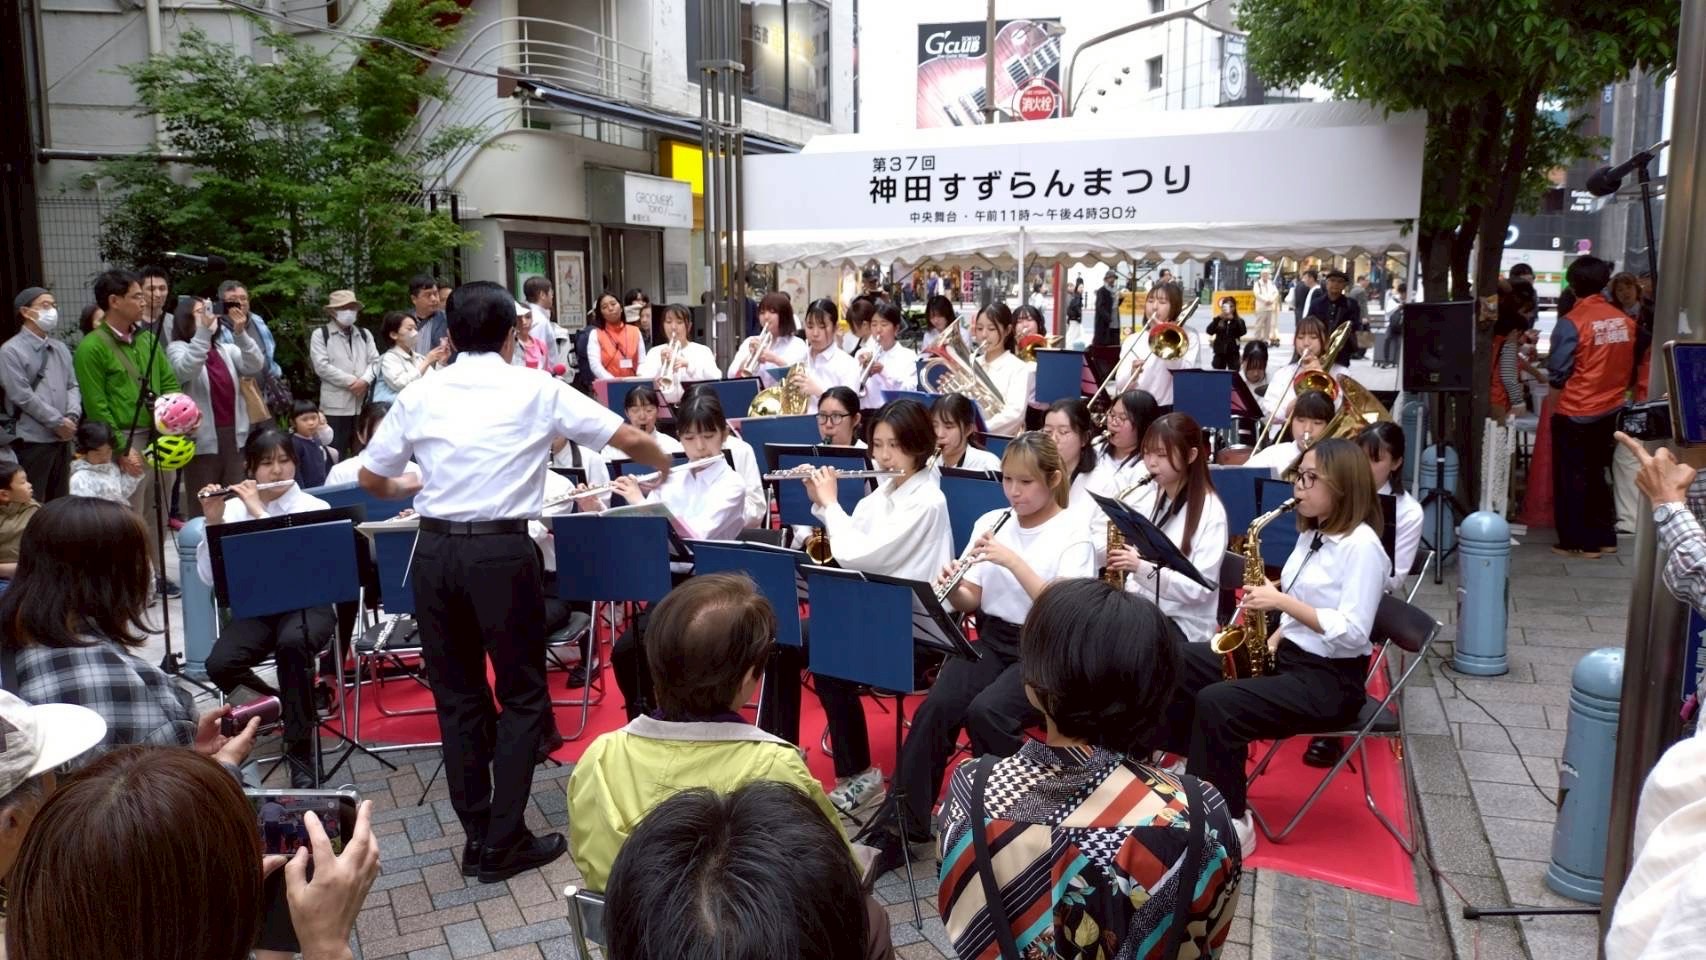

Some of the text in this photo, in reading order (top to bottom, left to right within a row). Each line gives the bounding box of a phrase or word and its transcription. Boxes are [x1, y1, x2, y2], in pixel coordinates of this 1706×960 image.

[1021, 95, 1052, 112] 消火栓
[872, 155, 936, 173] 第37回
[869, 164, 1191, 204] 神田すずらんまつり
